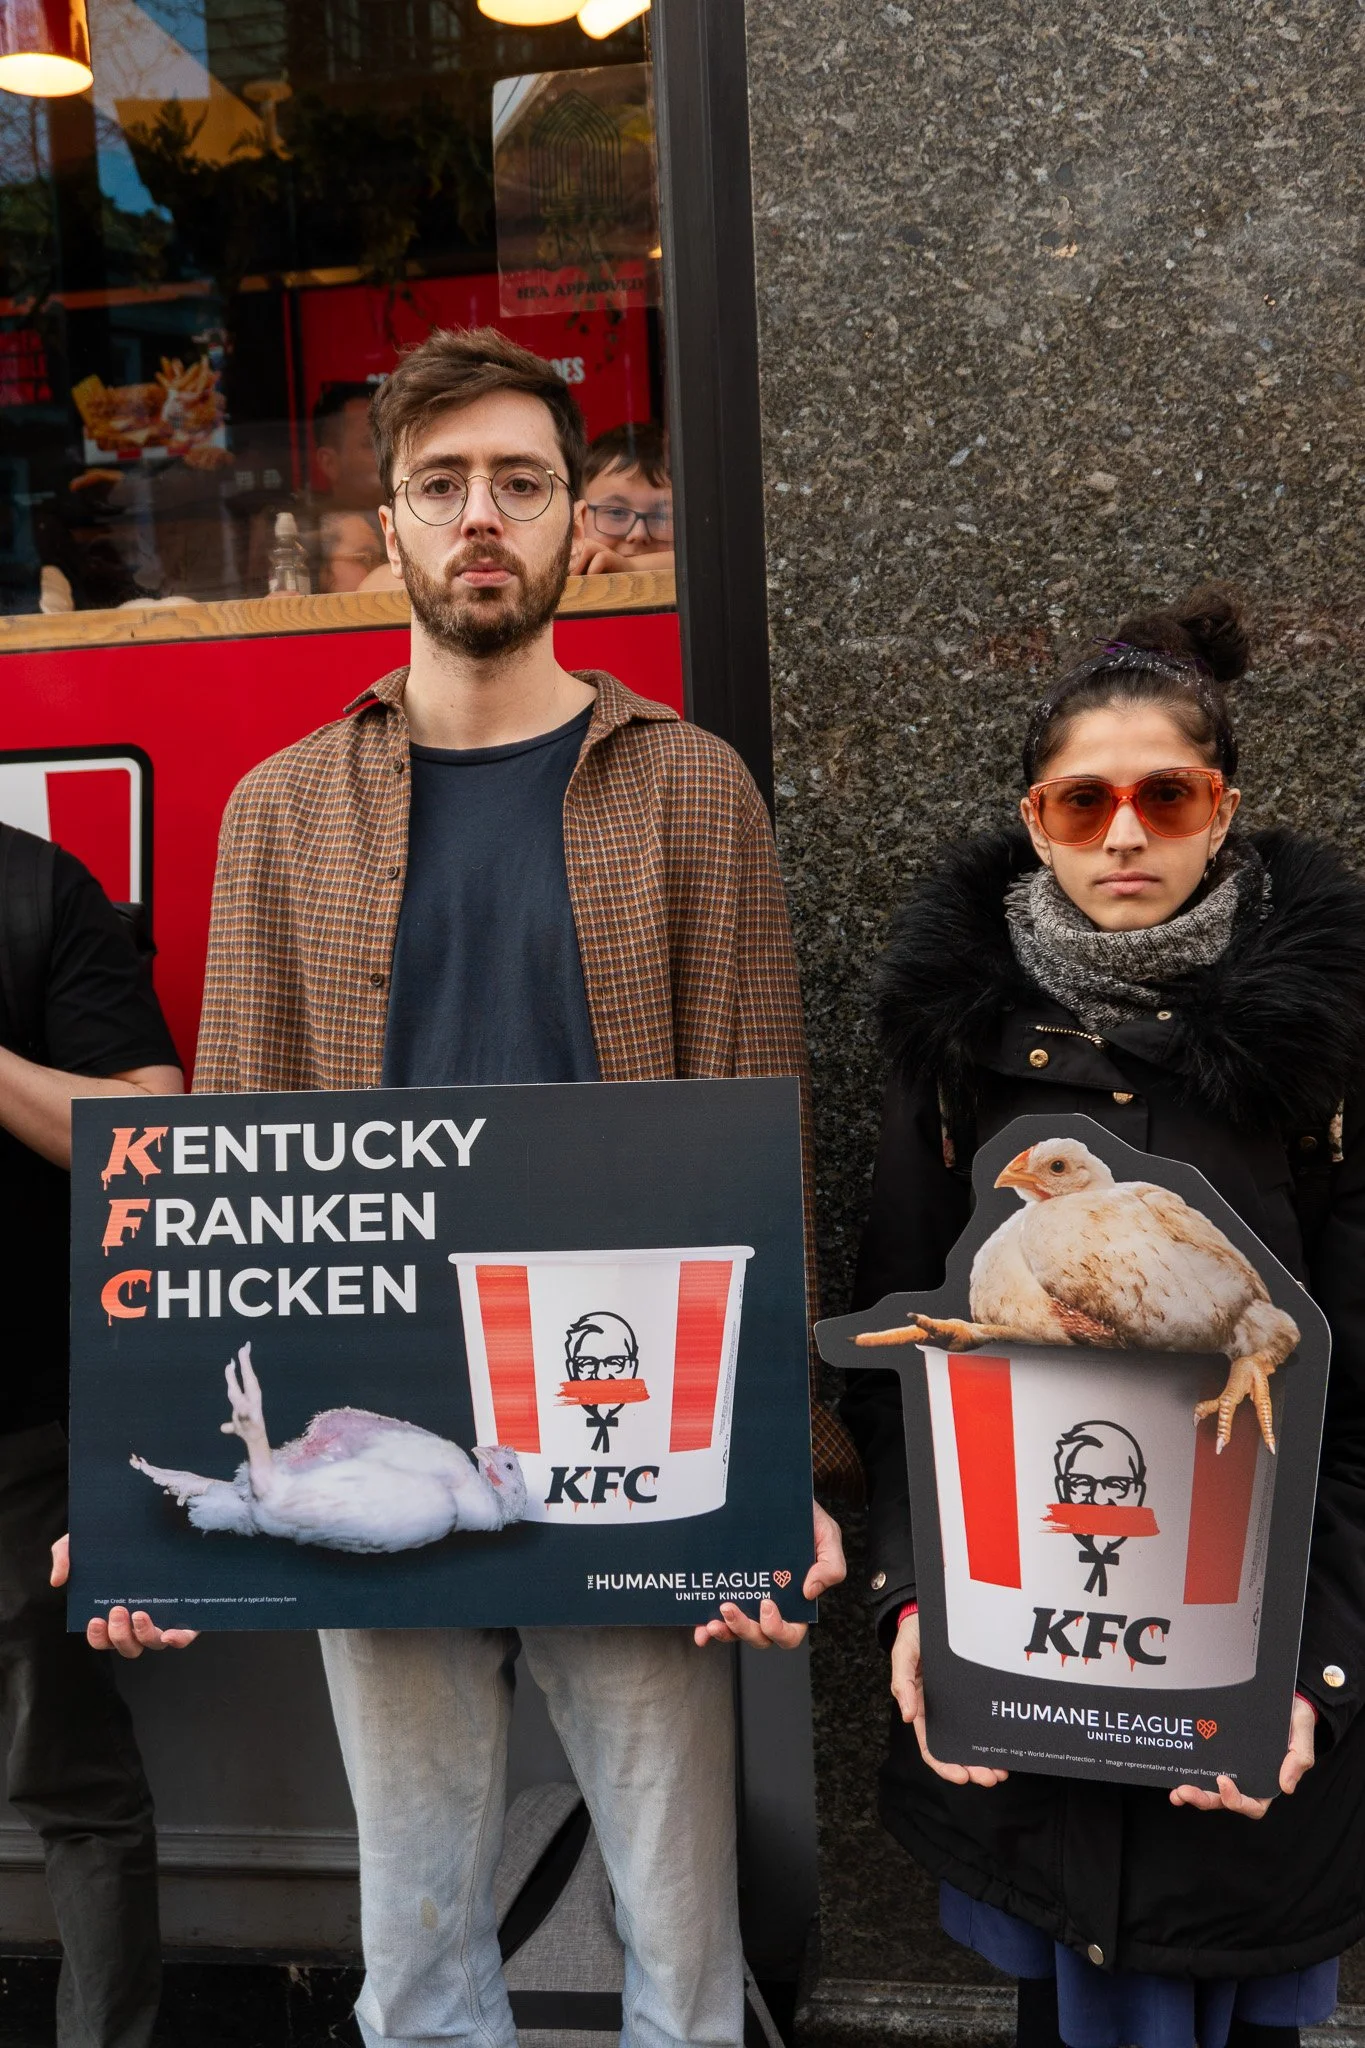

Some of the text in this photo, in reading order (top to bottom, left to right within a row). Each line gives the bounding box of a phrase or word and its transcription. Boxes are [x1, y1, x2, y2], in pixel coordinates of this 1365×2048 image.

[101, 1118, 487, 1190] KENTUCKY
[101, 1191, 436, 1256] FRANKEN
[101, 1264, 417, 1326] CHICKEN
[544, 1465, 660, 1512] KFC
[596, 1571, 770, 1590] HUMANE LEAGUE
[675, 1591, 771, 1601] UNITED KINGDOM
[1024, 1607, 1171, 1672] KFC
[991, 1700, 999, 1716] THE
[1001, 1701, 1194, 1737] HUMANE LEAGUE
[1087, 1731, 1194, 1750] UNITED KINGDOM
[972, 1745, 989, 1753] Image
[1028, 1750, 1045, 1758] World
[1045, 1752, 1065, 1760] Animal
[1066, 1754, 1096, 1764] Protection
[1105, 1759, 1124, 1767] Image
[1124, 1761, 1166, 1772] representative
[1179, 1767, 1200, 1775] typical
